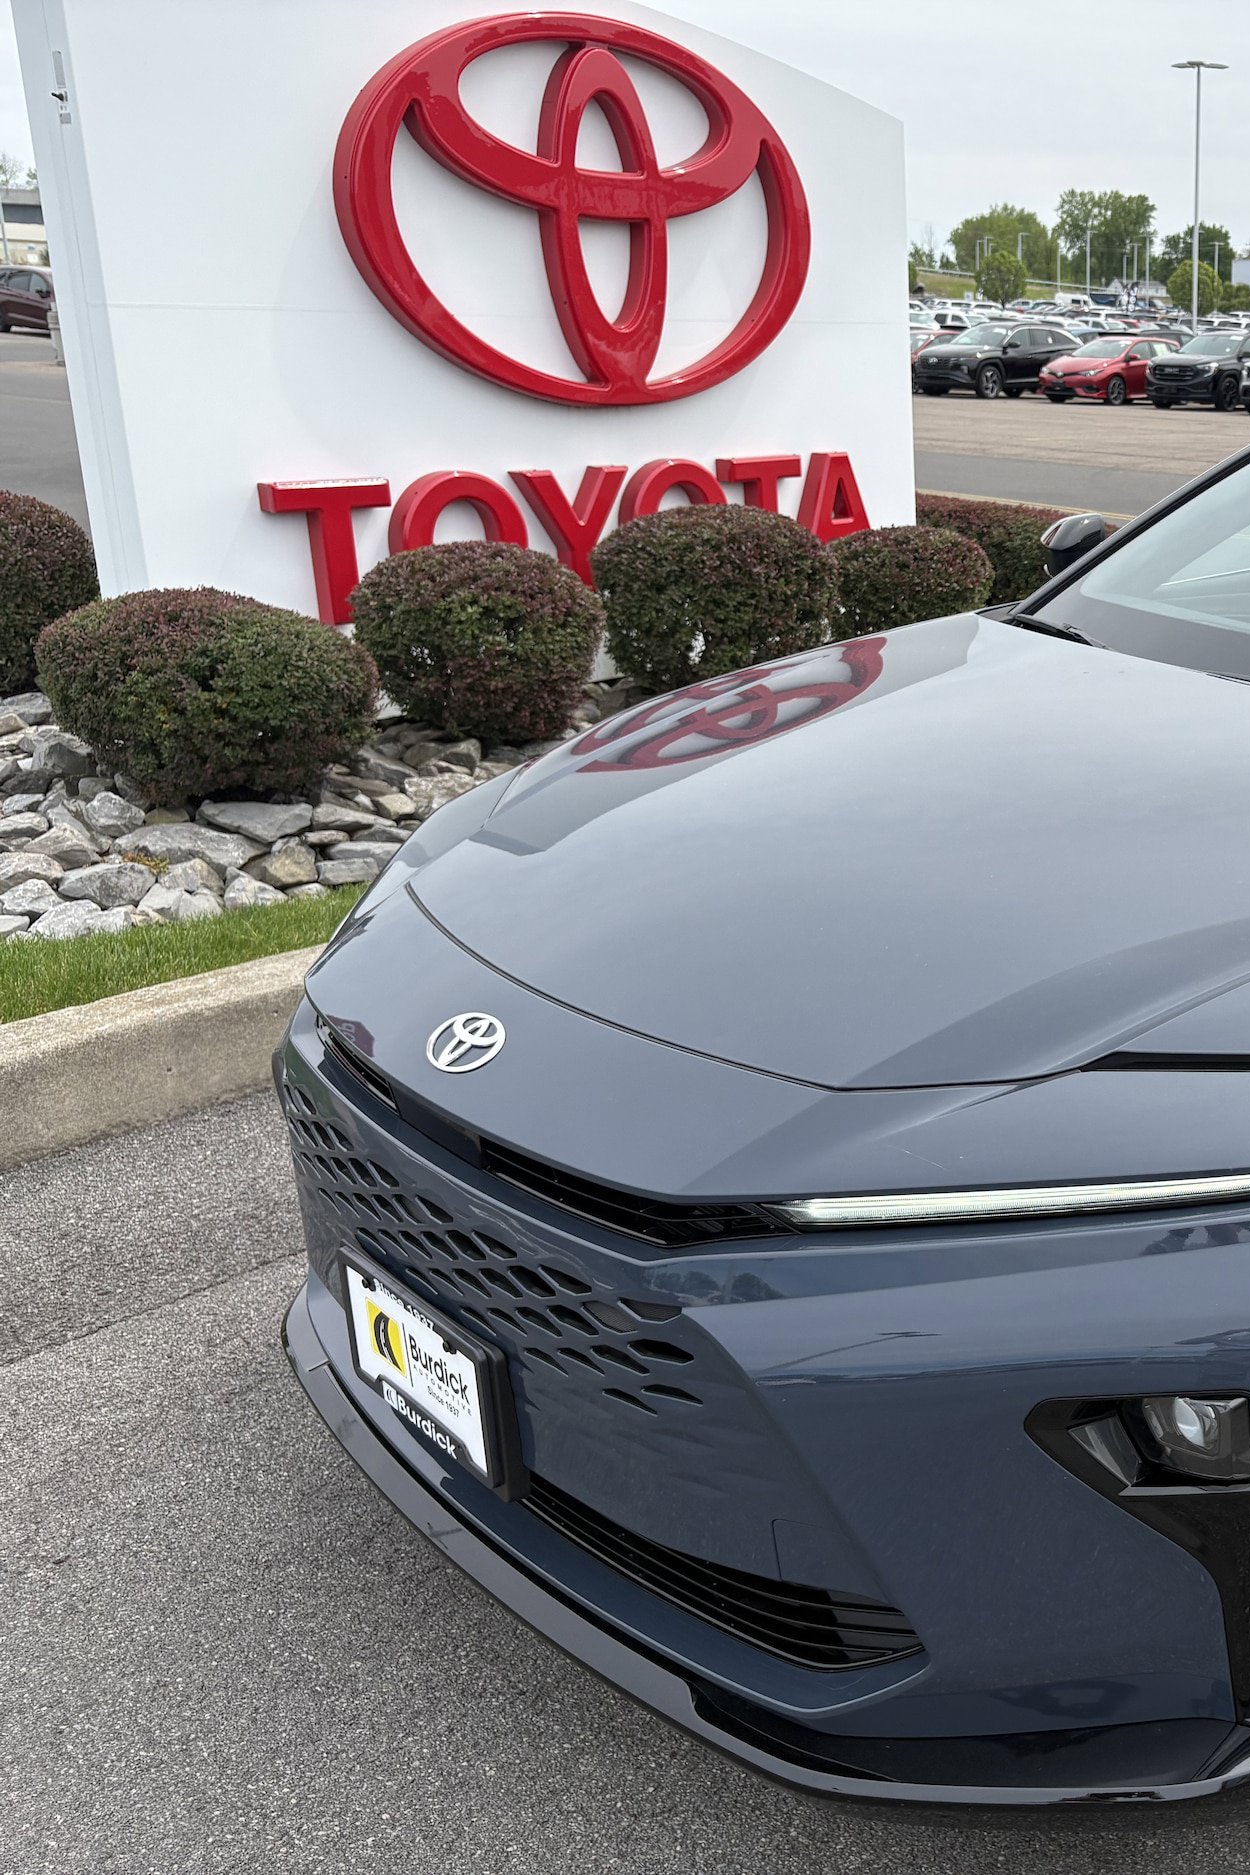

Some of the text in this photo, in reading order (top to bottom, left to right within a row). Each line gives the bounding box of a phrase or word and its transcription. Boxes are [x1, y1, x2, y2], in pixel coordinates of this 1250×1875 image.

[408, 1333, 470, 1405] Burdick
[414, 1364, 472, 1417] AUTOMOTIVE
[427, 1385, 444, 1405] Since
[397, 1394, 457, 1460] Burdick
